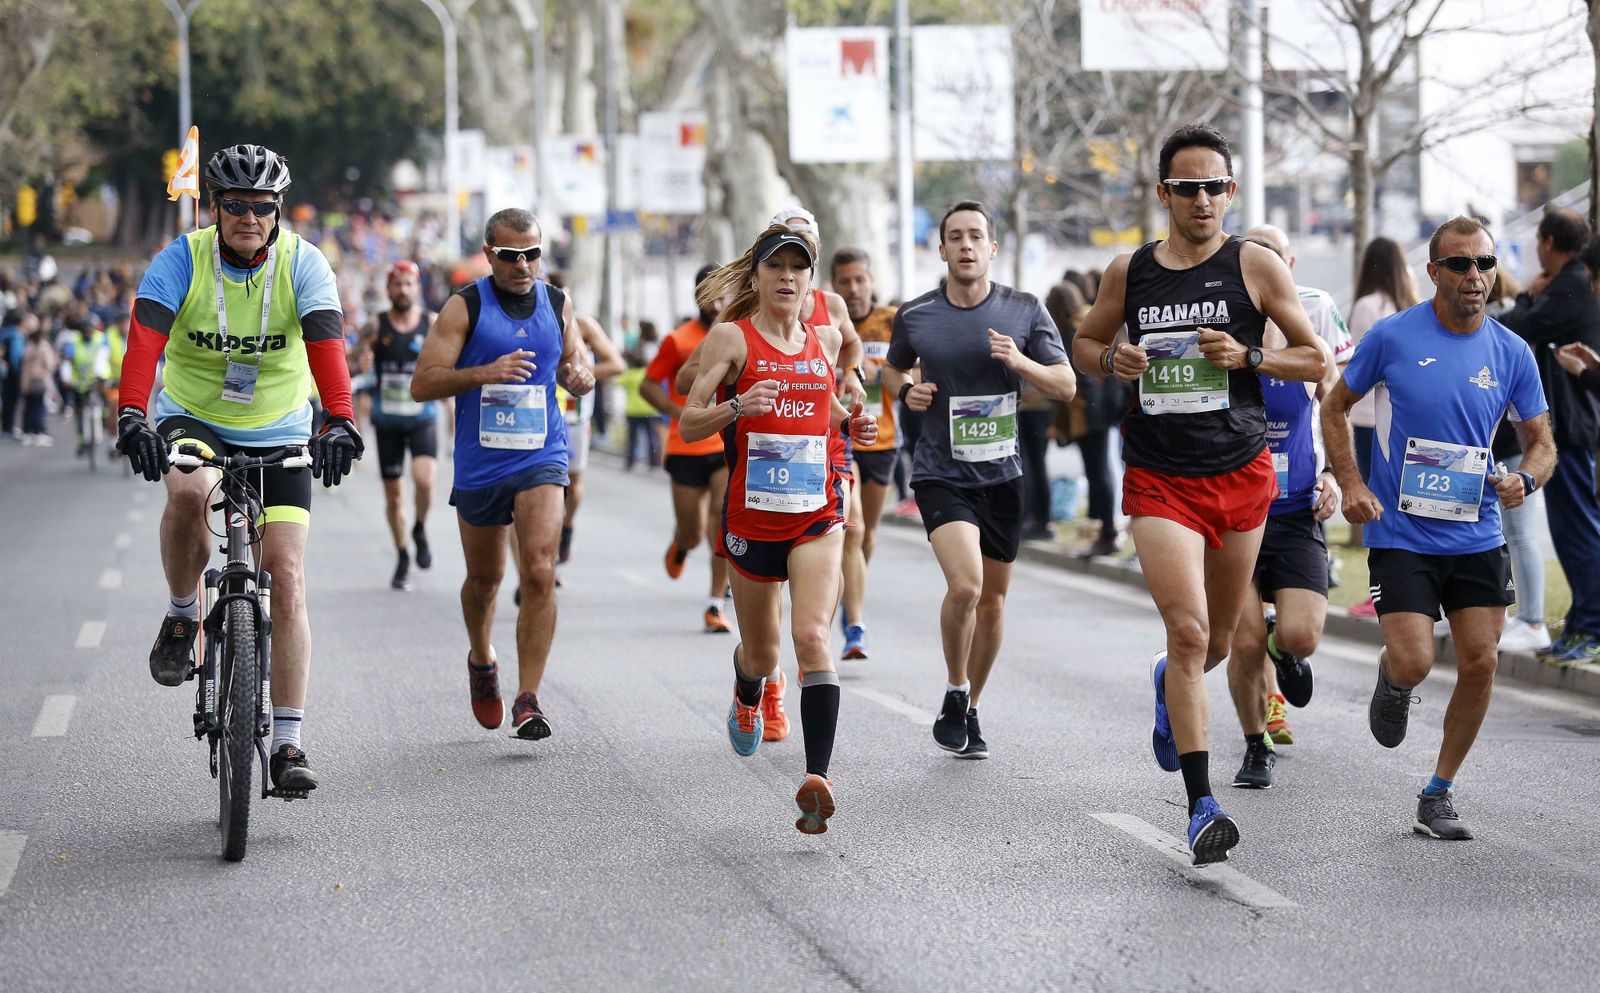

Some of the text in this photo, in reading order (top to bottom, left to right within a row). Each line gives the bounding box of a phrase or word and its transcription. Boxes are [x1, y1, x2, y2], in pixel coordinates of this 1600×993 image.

[173, 138, 197, 191] 2
[1138, 300, 1229, 324] GRANADA
[1148, 365, 1195, 384] 1419
[791, 382, 827, 391] FERTILIDAD
[773, 398, 815, 418] Vélez
[496, 411, 516, 426] 94
[959, 421, 997, 437] 1429
[767, 467, 790, 485] 19
[1417, 472, 1451, 492] 123
